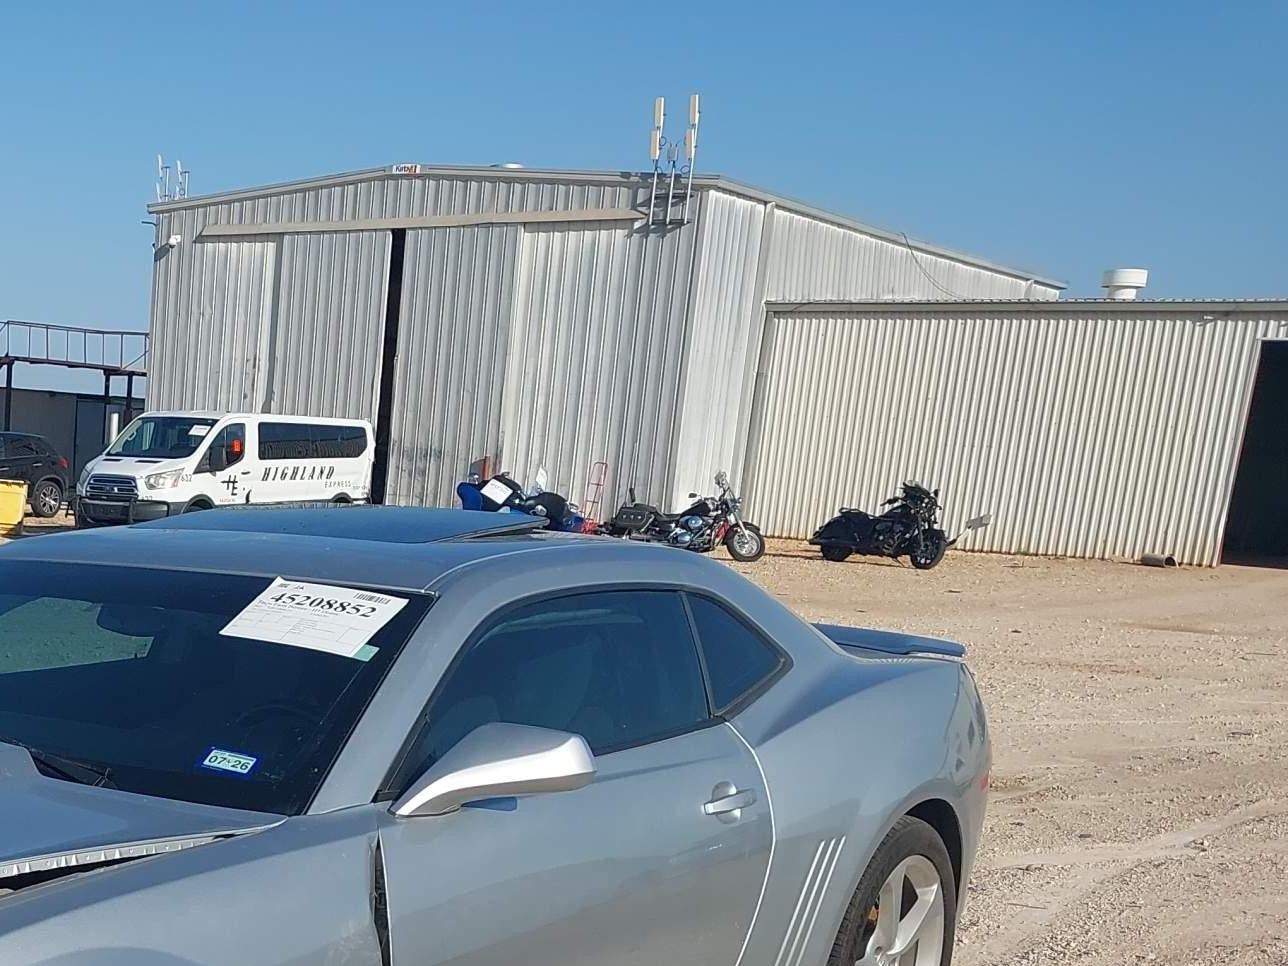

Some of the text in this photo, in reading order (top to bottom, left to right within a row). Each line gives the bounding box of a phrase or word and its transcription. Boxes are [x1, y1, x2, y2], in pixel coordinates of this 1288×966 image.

[261, 466, 335, 481] HIGHLAND
[324, 480, 352, 489] EXPRESS
[270, 592, 377, 618] 45208852
